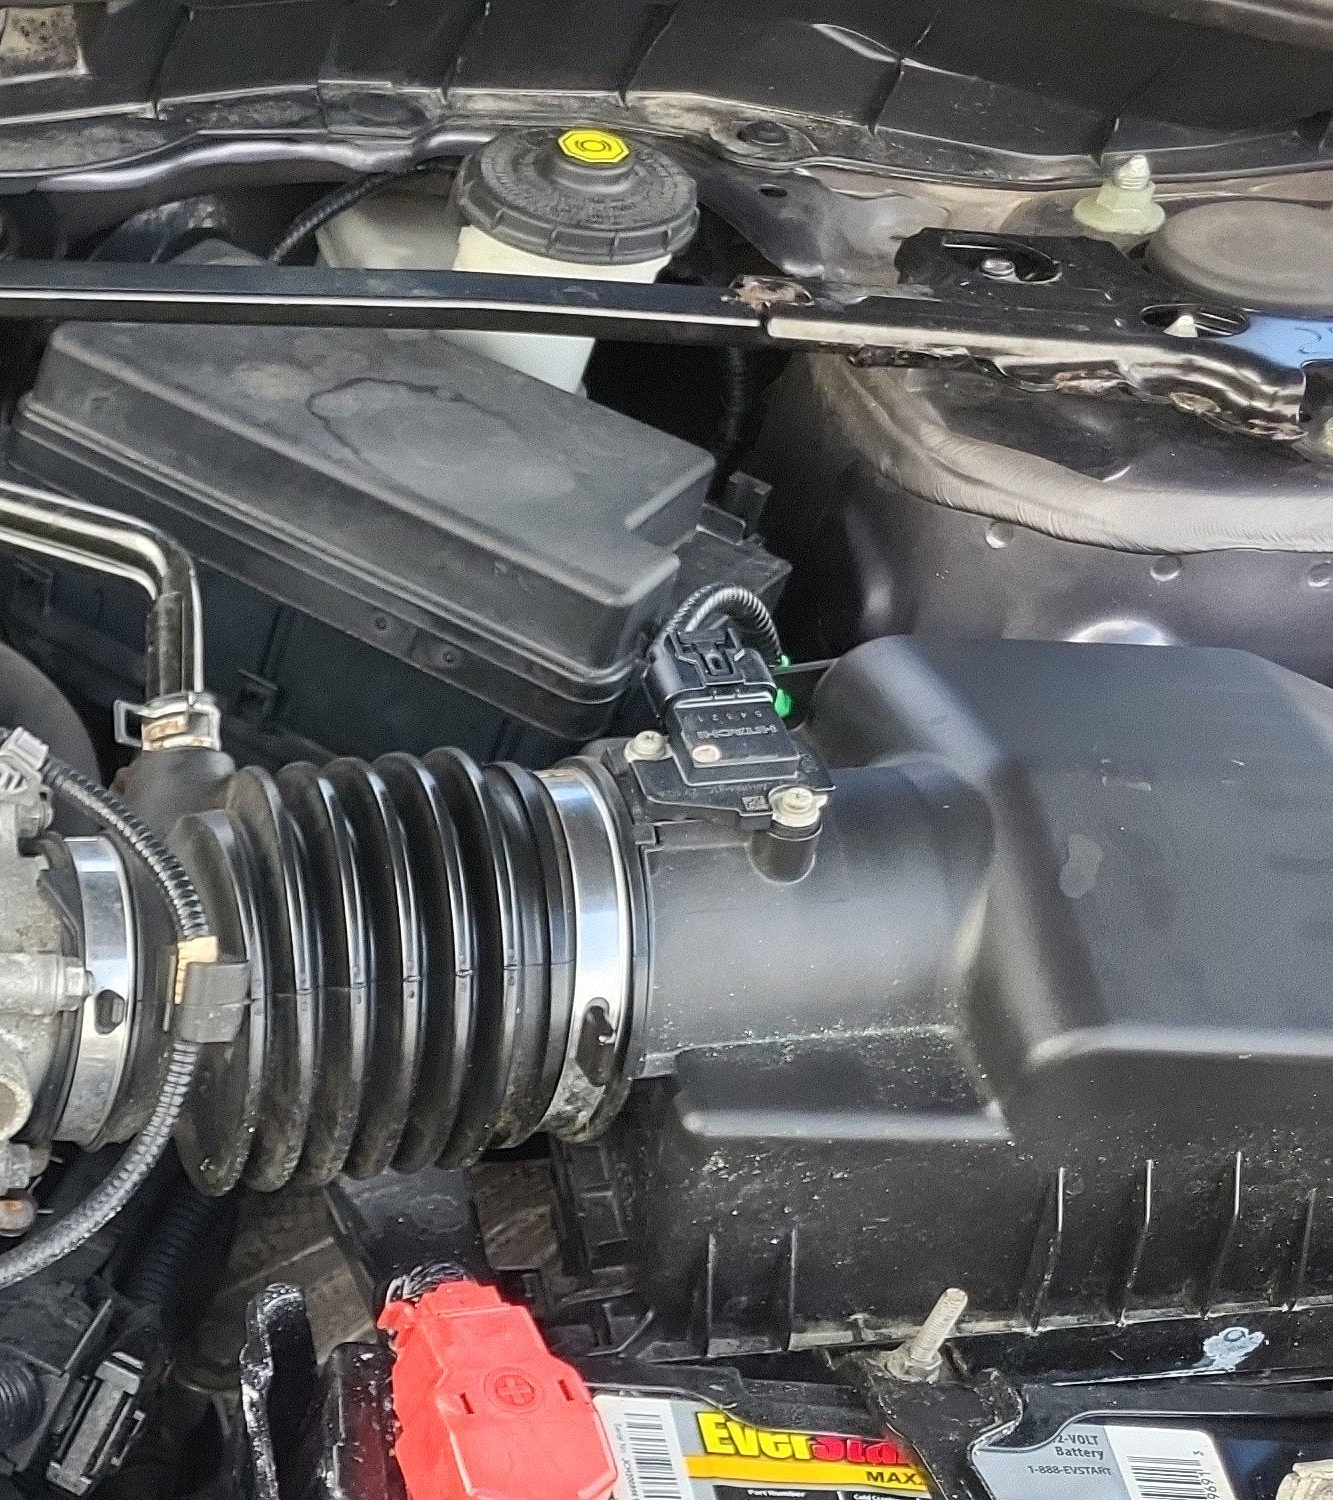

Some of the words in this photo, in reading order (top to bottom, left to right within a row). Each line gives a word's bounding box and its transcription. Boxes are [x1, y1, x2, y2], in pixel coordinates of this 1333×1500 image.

[1055, 1432, 1099, 1447] 2-VOLT
[1054, 1446, 1105, 1461] Battery
[1028, 1465, 1112, 1476] 1-888-EVSTART
